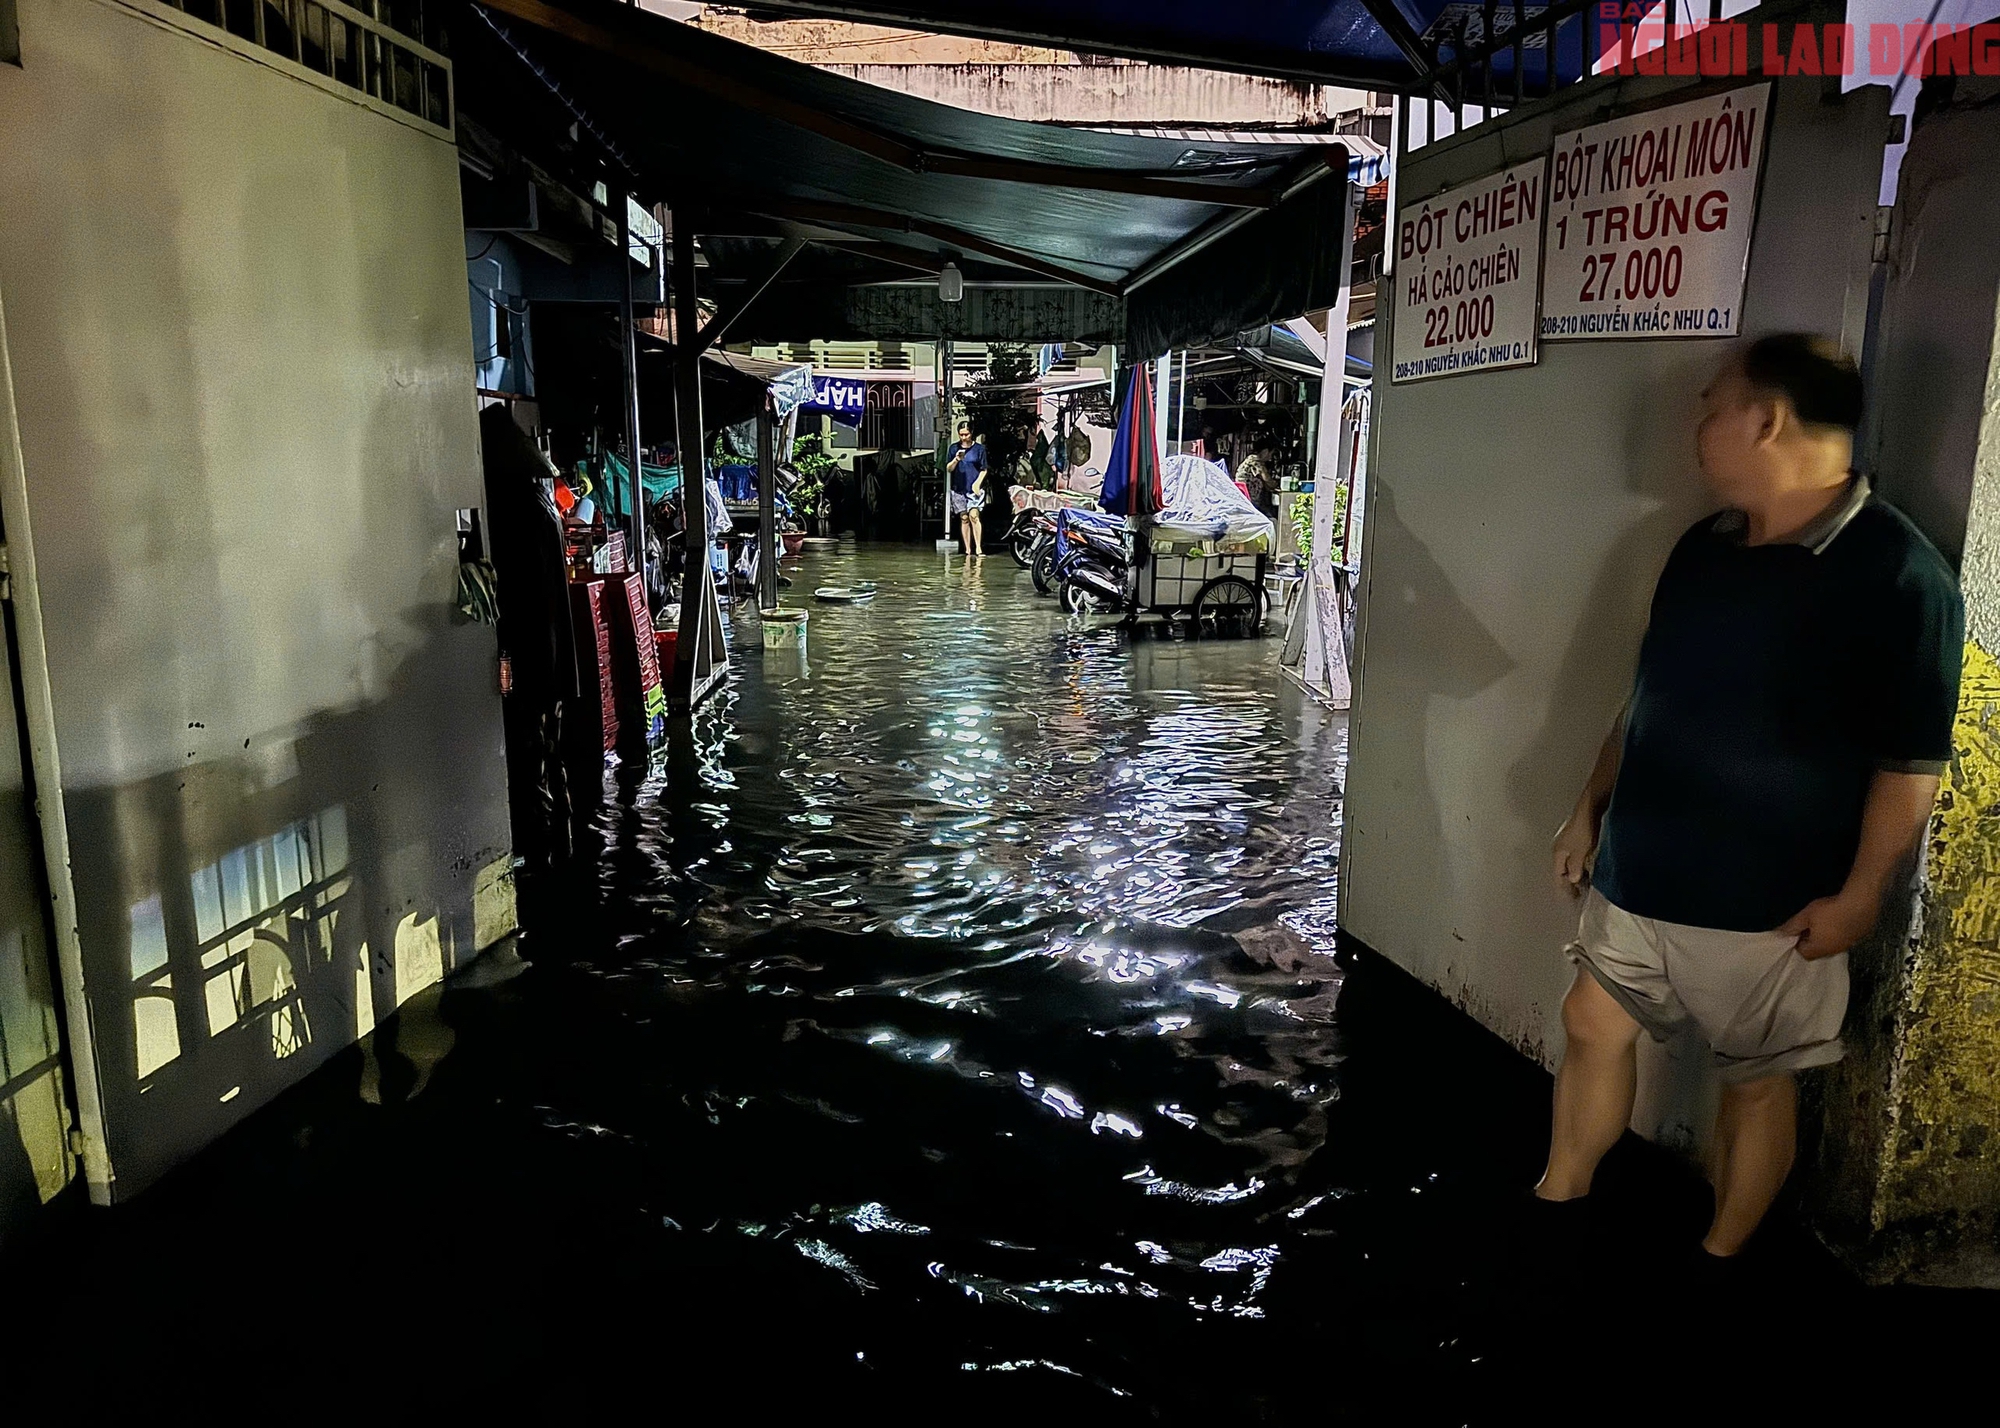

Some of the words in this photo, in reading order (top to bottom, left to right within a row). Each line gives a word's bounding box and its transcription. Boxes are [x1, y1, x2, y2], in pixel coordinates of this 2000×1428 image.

[1554, 133, 1598, 211] BỘT
[1600, 124, 1682, 194] KHOAI
[1685, 96, 1757, 179] MÔN
[1401, 203, 1449, 263] BỘT
[1455, 172, 1538, 244] CHIÊN
[1556, 215, 1568, 250] 1
[1582, 189, 1729, 246] TRỨNG
[1408, 265, 1428, 307] HÁ
[1432, 254, 1465, 301] CẢO
[1468, 243, 1520, 292] CHIÊN
[1579, 245, 1683, 302] 27.000
[1424, 294, 1495, 348] 22.000
[1540, 316, 1577, 335] 208-210
[1579, 305, 1630, 333] NGUYỄN
[1633, 302, 1670, 331] KHẮC
[1673, 308, 1704, 331] NHU
[1707, 307, 1731, 330] Q.1
[1395, 359, 1424, 379] 208-210
[1461, 340, 1487, 368] KHẮC
[1488, 344, 1511, 364] NHU
[1513, 341, 1529, 360] Q.1
